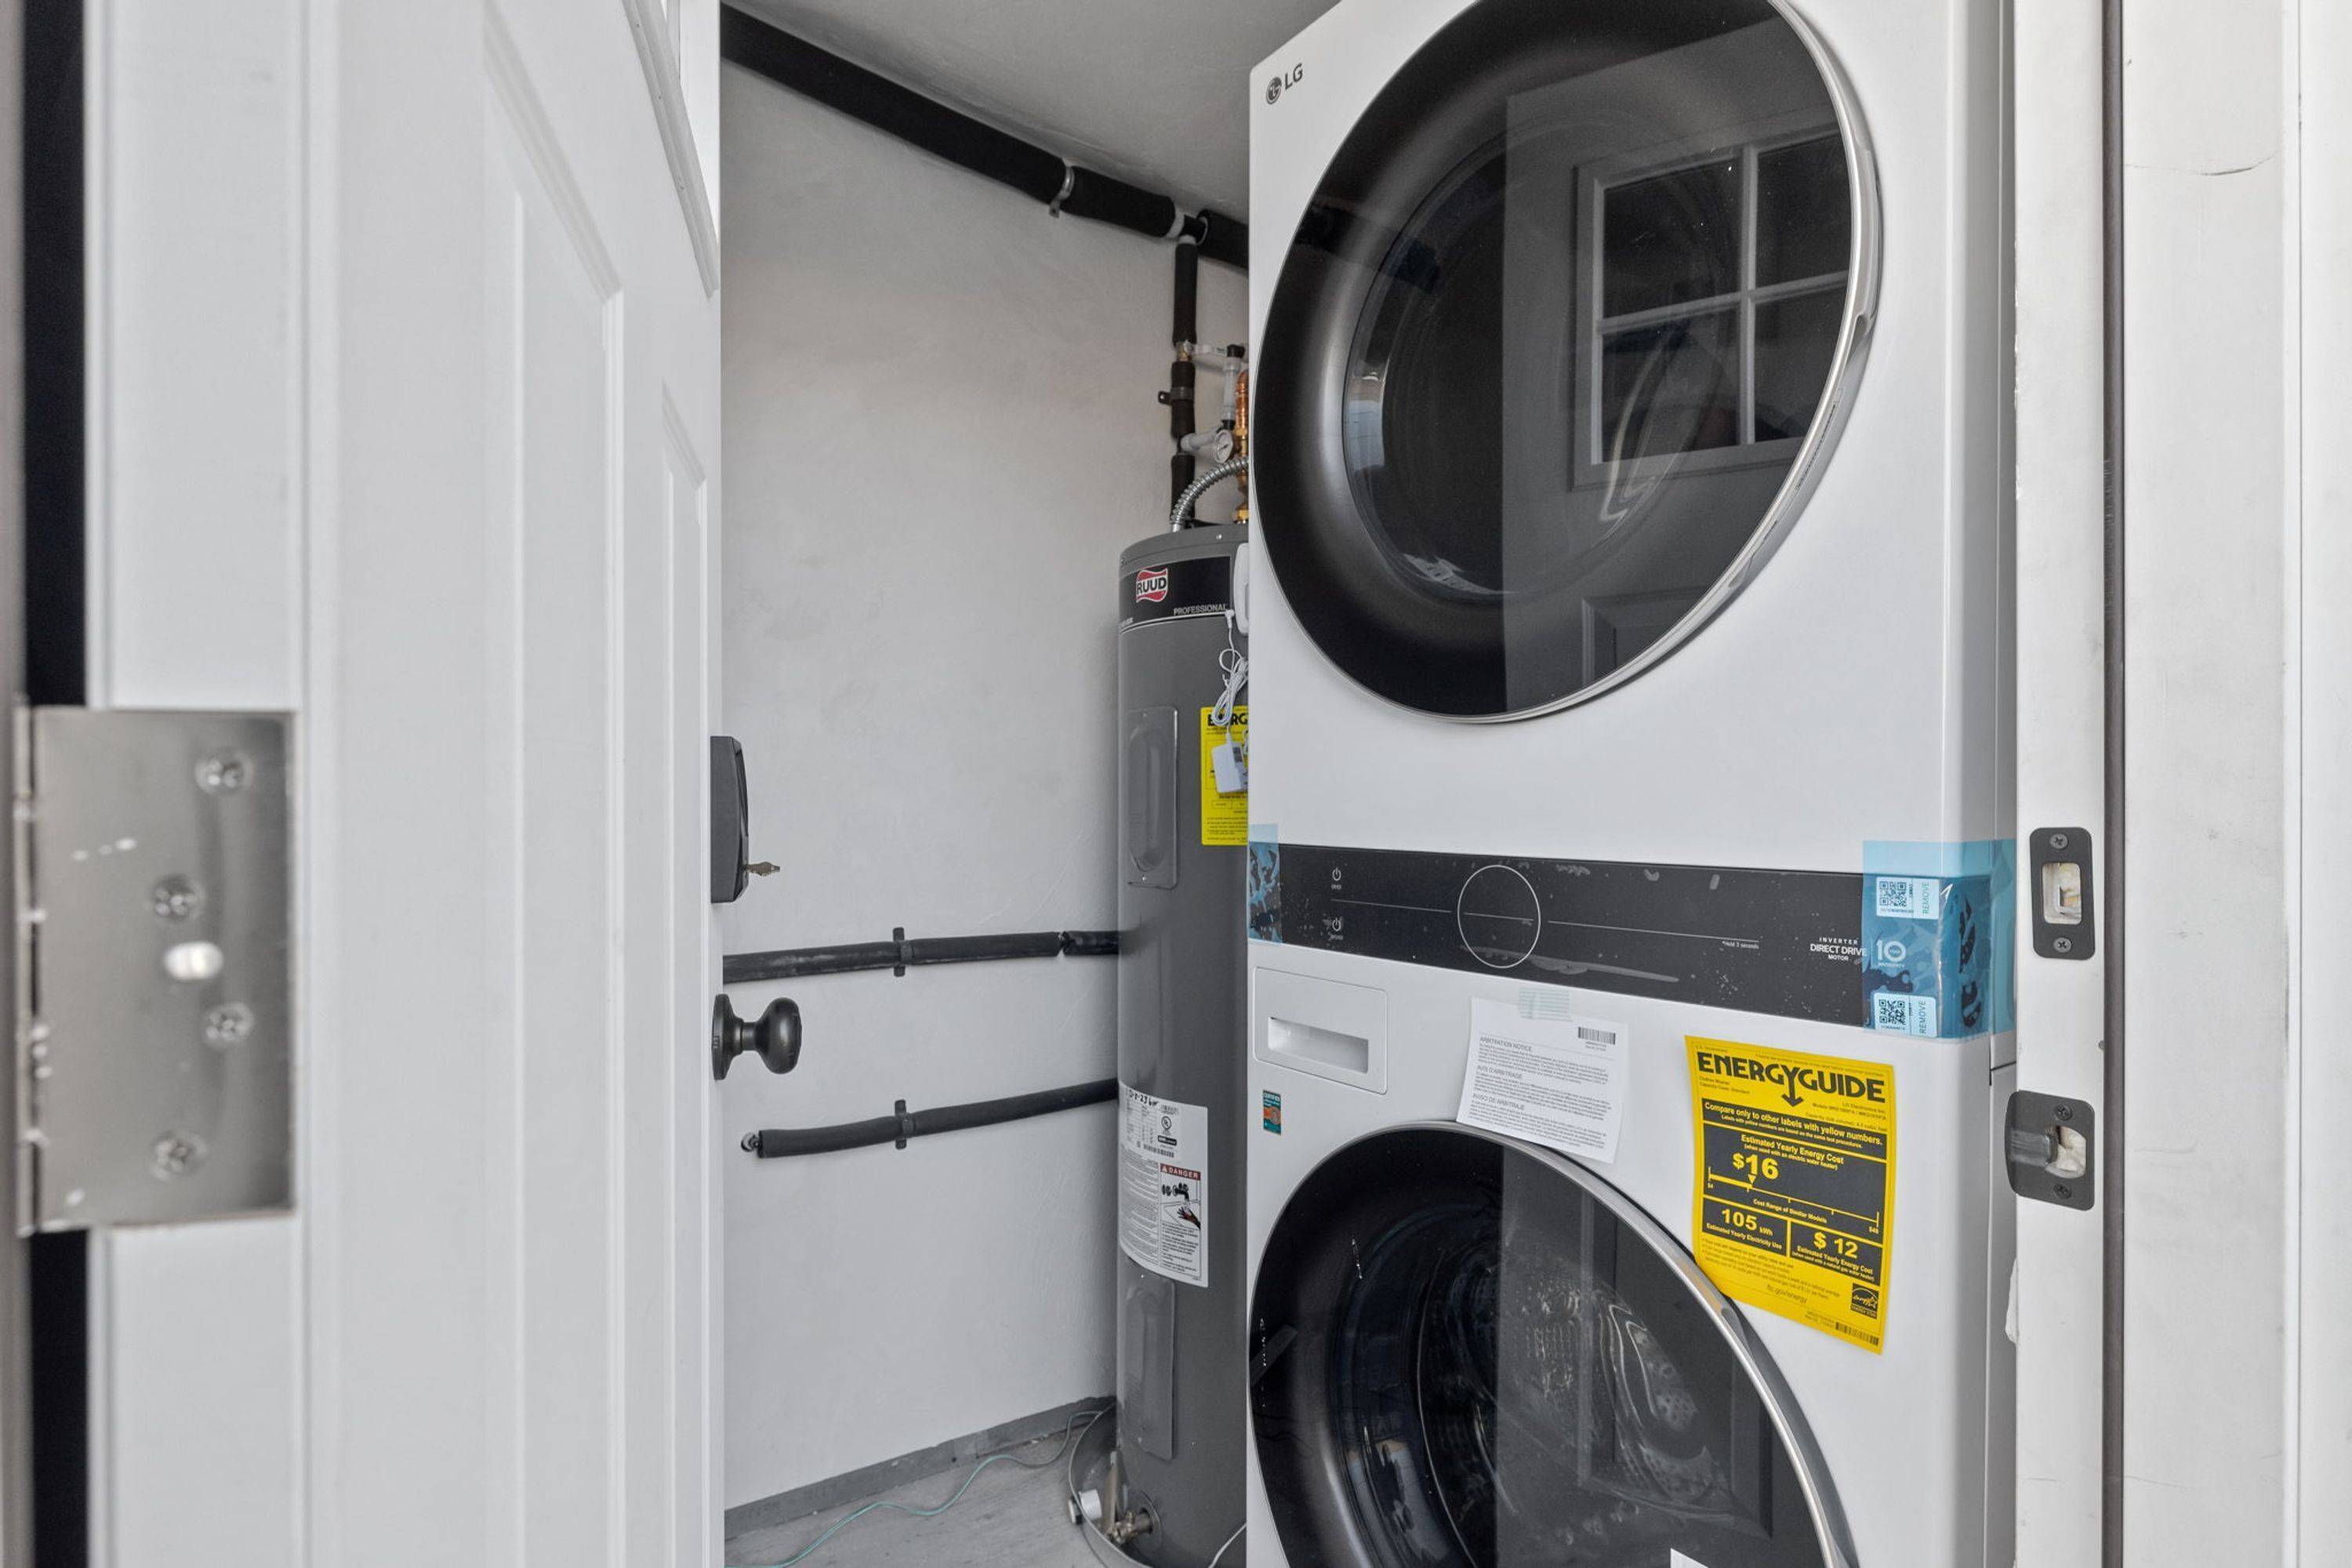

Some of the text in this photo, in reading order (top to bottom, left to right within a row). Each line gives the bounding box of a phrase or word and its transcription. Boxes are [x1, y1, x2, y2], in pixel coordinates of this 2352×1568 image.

[1285, 63, 1303, 90] LG
[1137, 577, 1167, 594] RUUD
[1174, 604, 1226, 615] PROFESSIONAL
[1809, 943, 1867, 956] DIRECT DRIVE
[1819, 937, 1858, 946] INVERTER
[1876, 939, 1907, 963] 10
[1918, 1000, 1927, 1034] REMOVE
[1697, 1051, 1886, 1106] ENERGYGUIDE
[1704, 1102, 1735, 1114] Compare
[1736, 1108, 1751, 1120] only
[1760, 1114, 1780, 1123] other
[1780, 1116, 1802, 1128] labels
[1803, 1122, 1820, 1132] with
[1820, 1126, 1846, 1137] yellow
[1846, 1132, 1882, 1145] numbers.
[1740, 1134, 1844, 1165] Estimated Yearly Energy Cost
[1169, 1167, 1199, 1179] DANGER
[1732, 1152, 1779, 1180] $16
[1722, 1208, 1773, 1236] 105 kWh
[1766, 1202, 1782, 1211] Range
[1808, 1213, 1828, 1223] Models
[1706, 1222, 1730, 1235] Estimated
[1731, 1229, 1746, 1240] Yearly
[1746, 1234, 1771, 1247] Electricity
[1772, 1240, 1782, 1250] Use
[1813, 1232, 1827, 1250] $
[1834, 1238, 1858, 1259] 12
[1797, 1245, 1823, 1259] Estimated
[1824, 1253, 1840, 1265] Yearly
[1840, 1258, 1860, 1271] Energy
[1860, 1265, 1873, 1275] Cost
